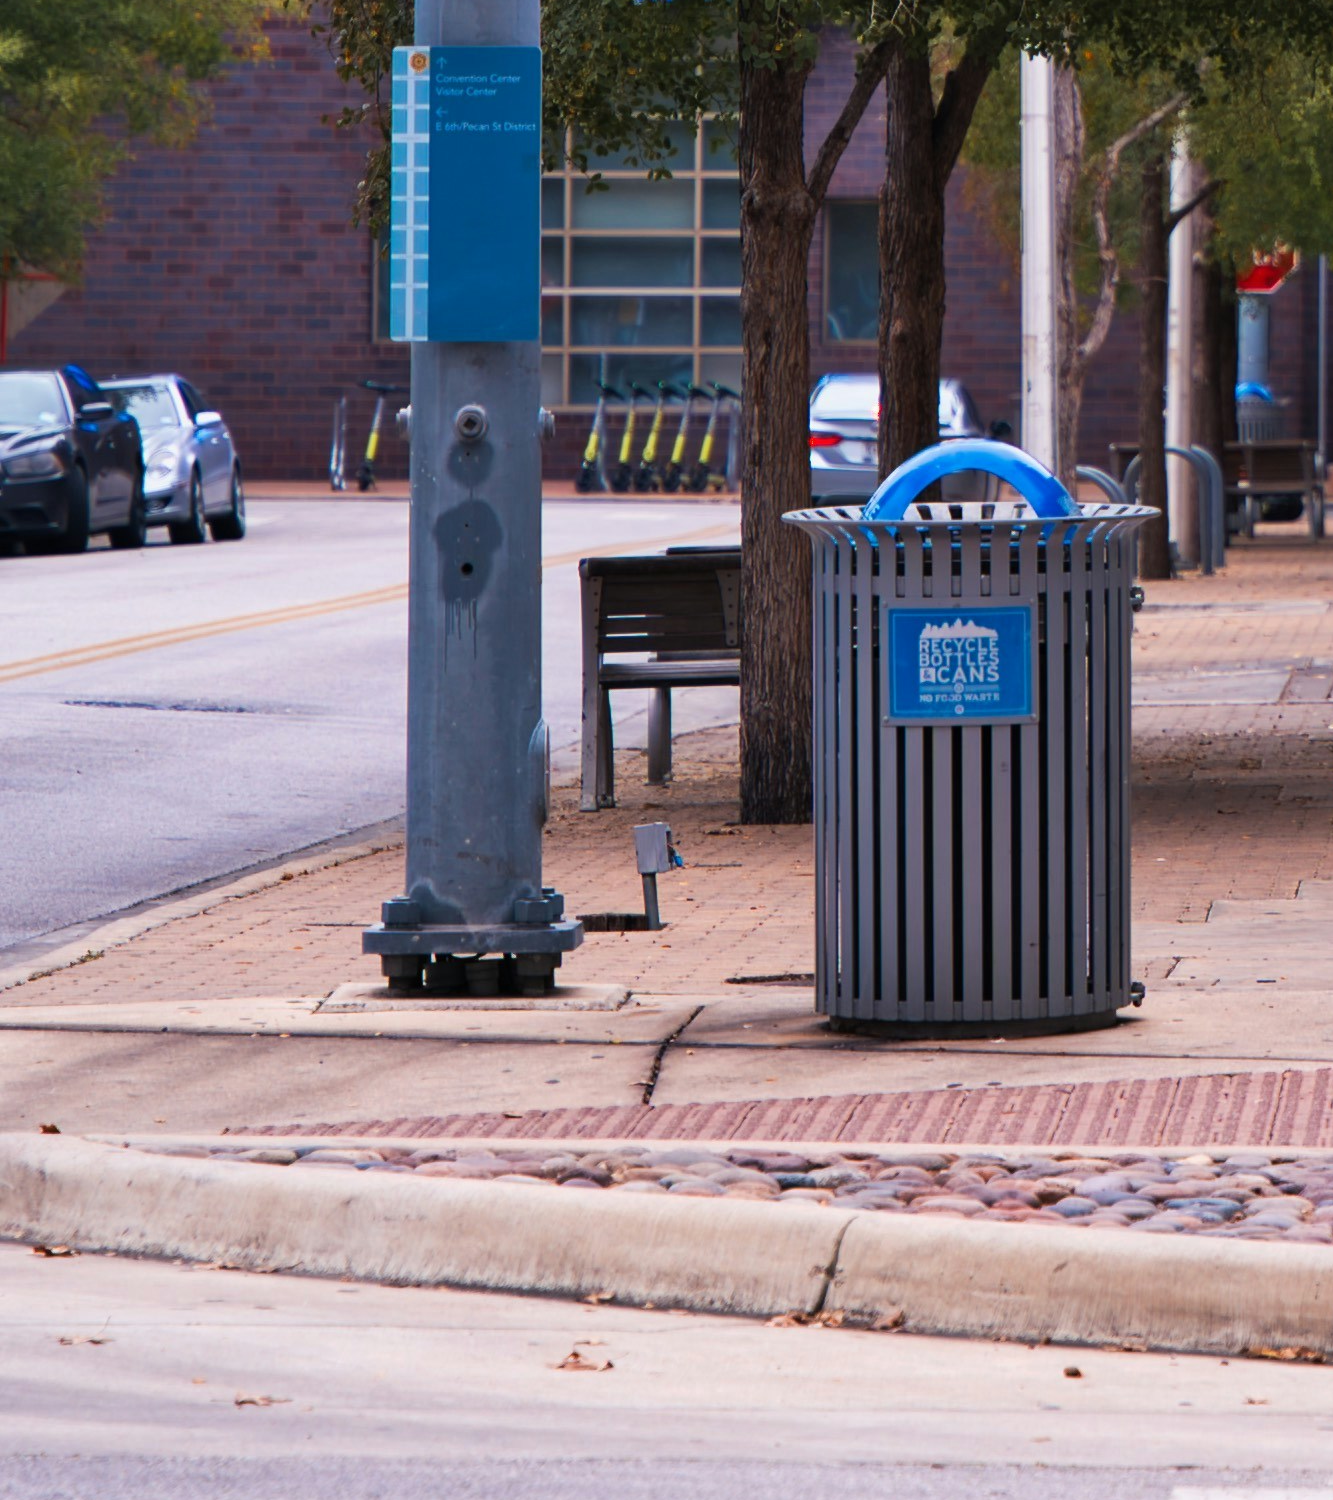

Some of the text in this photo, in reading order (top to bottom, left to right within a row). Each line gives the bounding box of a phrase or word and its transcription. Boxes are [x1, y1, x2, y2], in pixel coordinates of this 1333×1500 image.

[435, 73, 521, 83] Convention Center
[435, 86, 497, 96] Visitor Center
[435, 122, 441, 131] E
[492, 121, 501, 131] St
[503, 121, 536, 131] District
[919, 637, 999, 653] RECYCLE
[919, 652, 999, 667] BOTTLES
[937, 666, 1000, 683] CANS
[935, 693, 962, 702] FOOD
